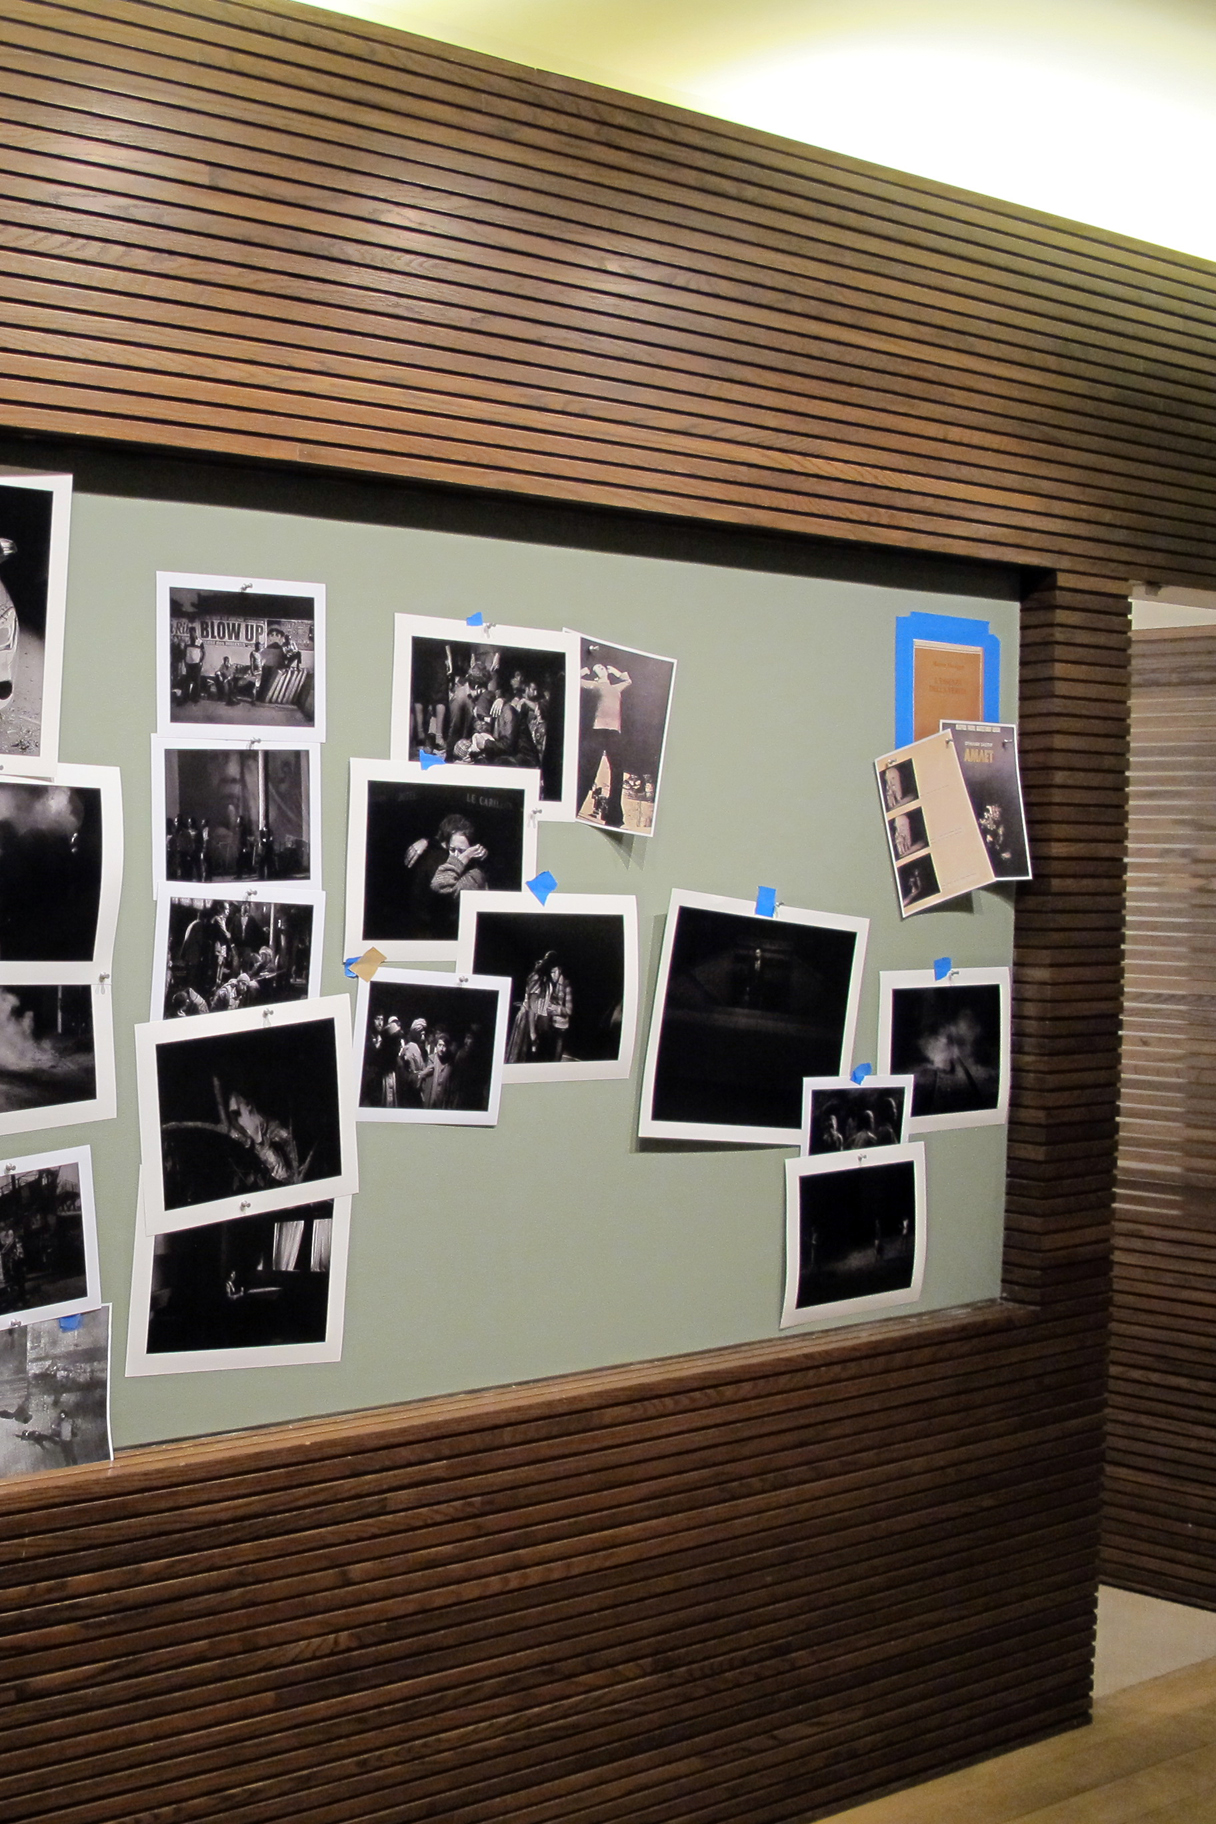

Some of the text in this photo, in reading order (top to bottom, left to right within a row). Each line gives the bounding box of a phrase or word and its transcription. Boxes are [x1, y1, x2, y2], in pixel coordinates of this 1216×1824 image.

[200, 620, 241, 641] BLOW
[245, 624, 264, 643] UP
[466, 793, 477, 804] LE
